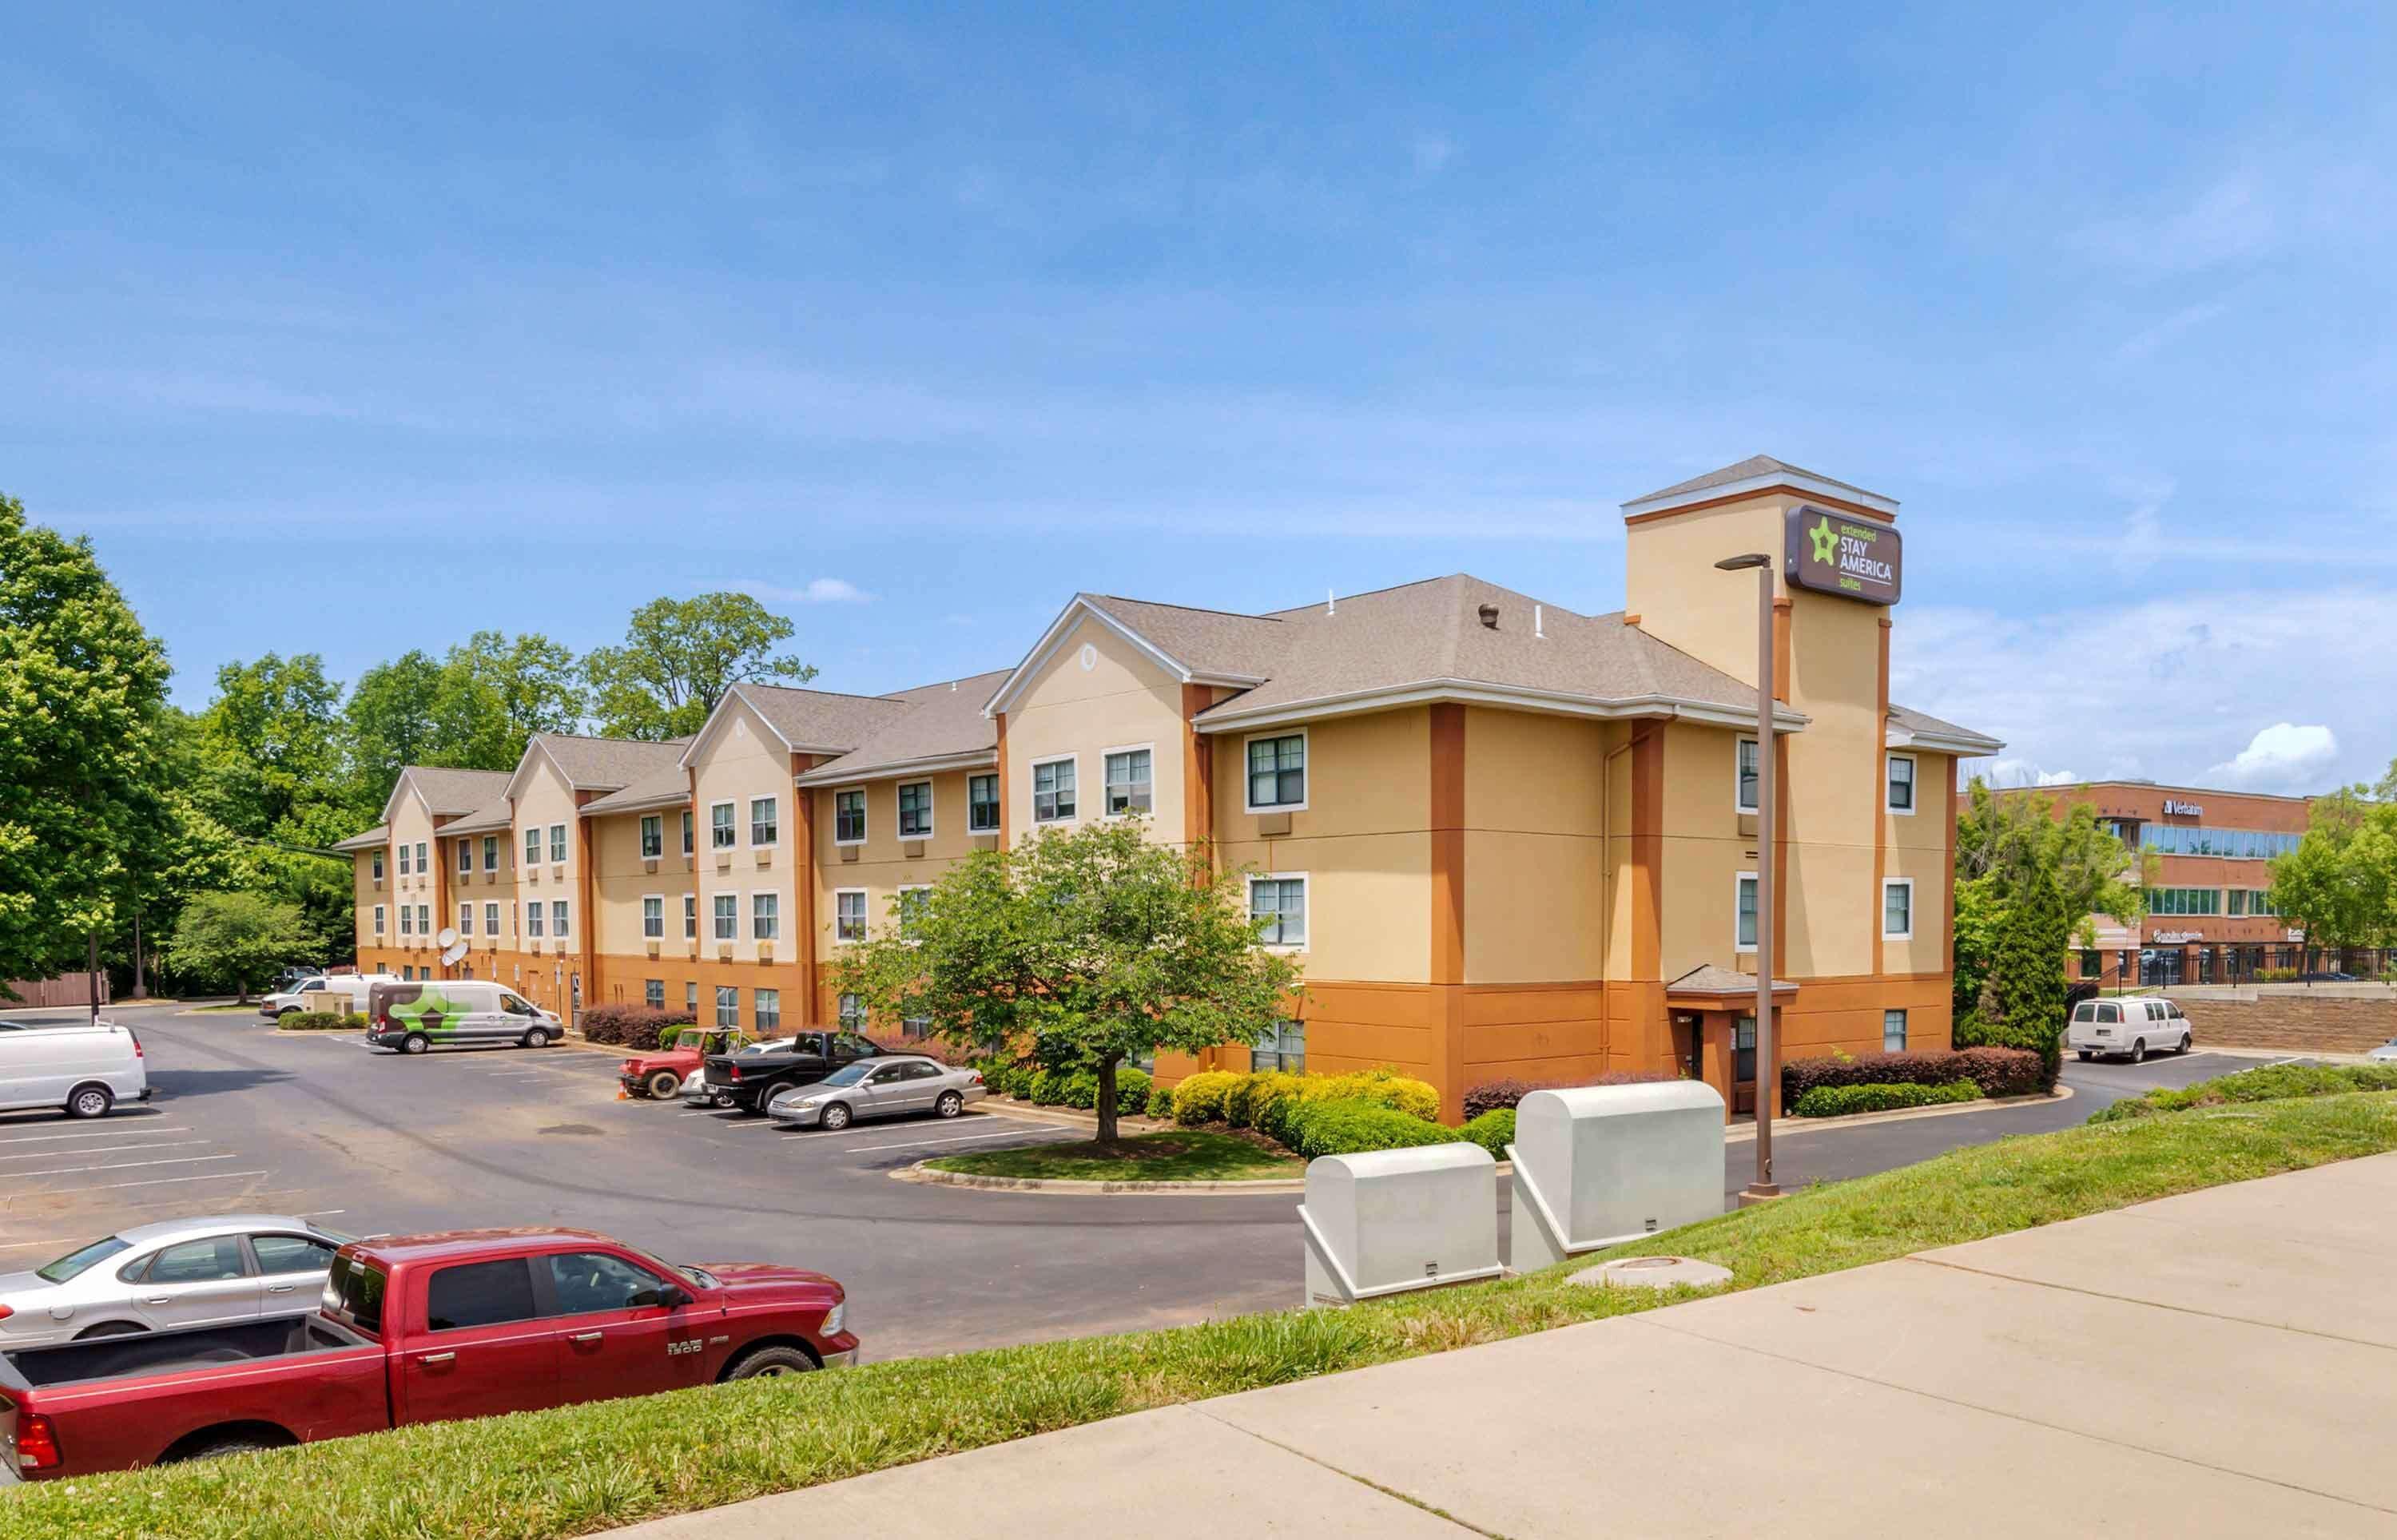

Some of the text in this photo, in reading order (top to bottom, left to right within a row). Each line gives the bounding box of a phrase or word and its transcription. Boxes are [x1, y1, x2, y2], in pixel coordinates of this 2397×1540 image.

[1841, 525, 1876, 542] extended
[1841, 536, 1866, 557] STAY
[1840, 554, 1891, 580] AMERICA
[1840, 578, 1861, 591] suites
[667, 1339, 702, 1348] RAM
